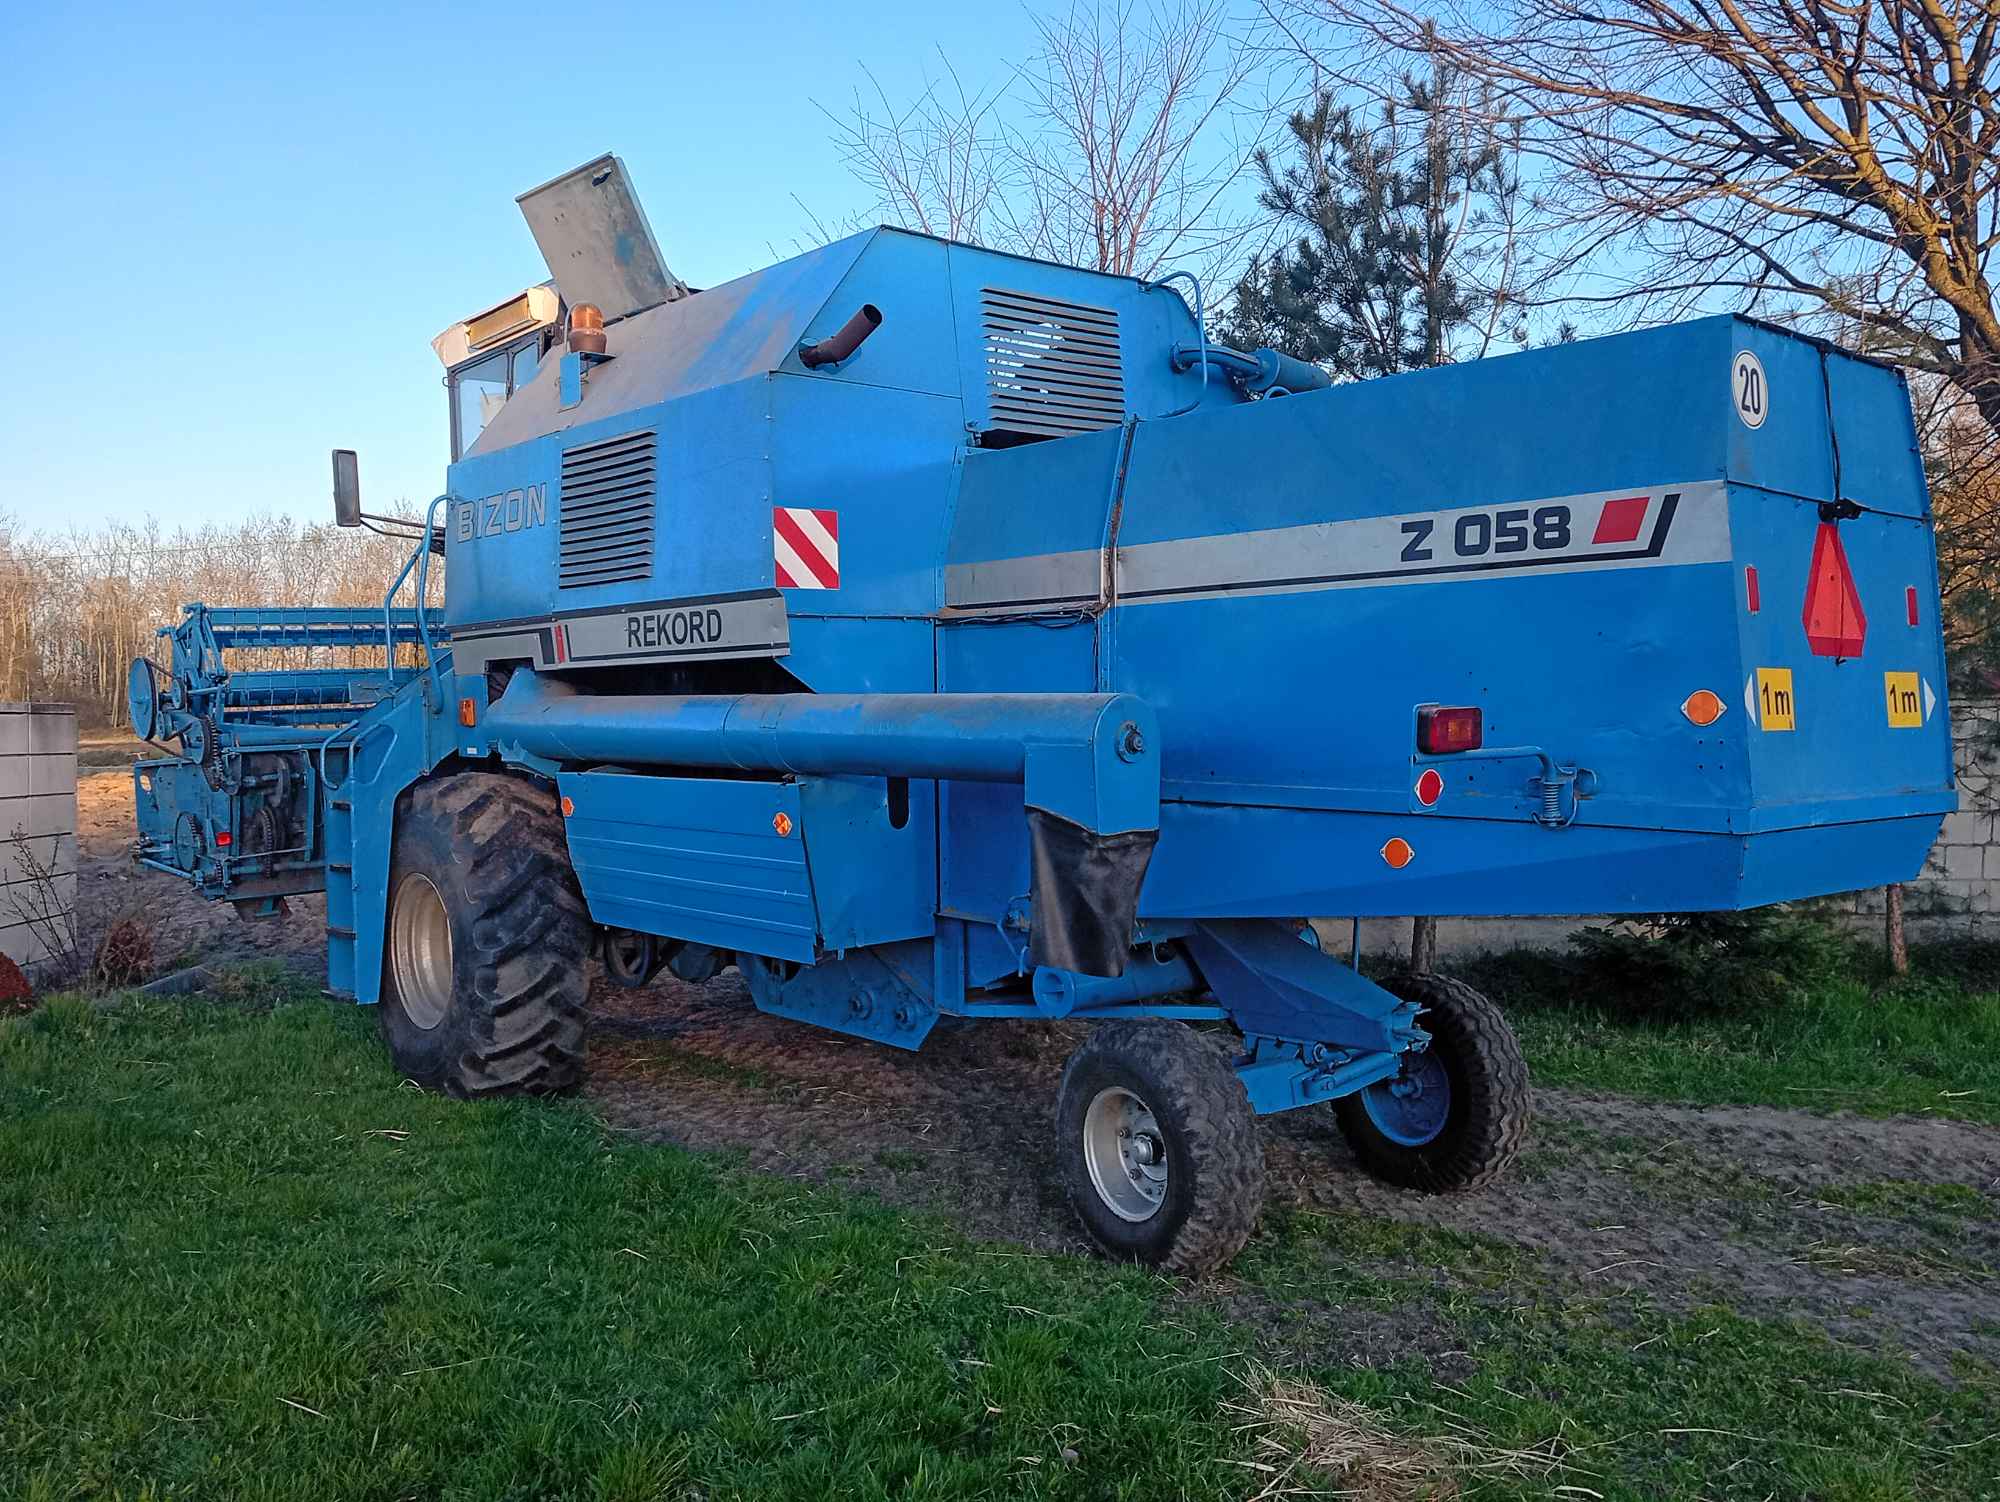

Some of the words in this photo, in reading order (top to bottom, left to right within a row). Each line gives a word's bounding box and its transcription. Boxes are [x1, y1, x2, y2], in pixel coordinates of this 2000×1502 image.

[1740, 365, 1760, 414] 20
[456, 483, 546, 543] BIZON
[1402, 520, 1433, 562] Z
[1455, 506, 1571, 556] 058
[628, 610, 722, 648] REKORD
